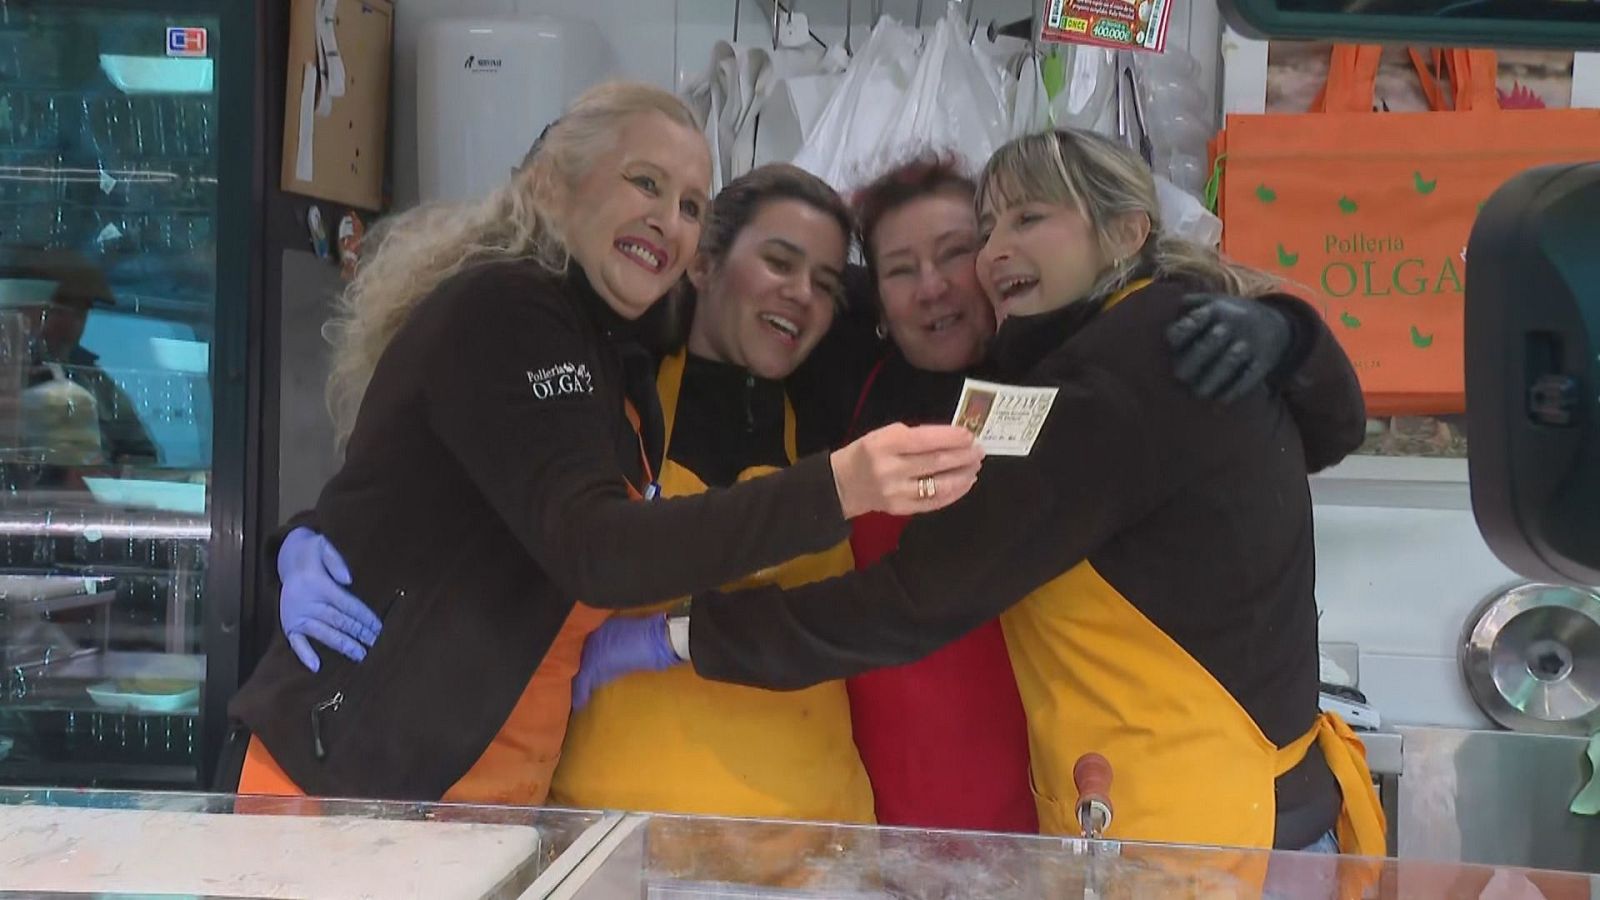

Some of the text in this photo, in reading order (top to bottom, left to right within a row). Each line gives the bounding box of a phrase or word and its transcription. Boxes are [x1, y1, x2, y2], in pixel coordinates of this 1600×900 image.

[1068, 19, 1086, 31] ONCE
[1093, 24, 1131, 41] 400.000€
[1320, 256, 1464, 298] OLGA
[533, 374, 585, 399] OLGA
